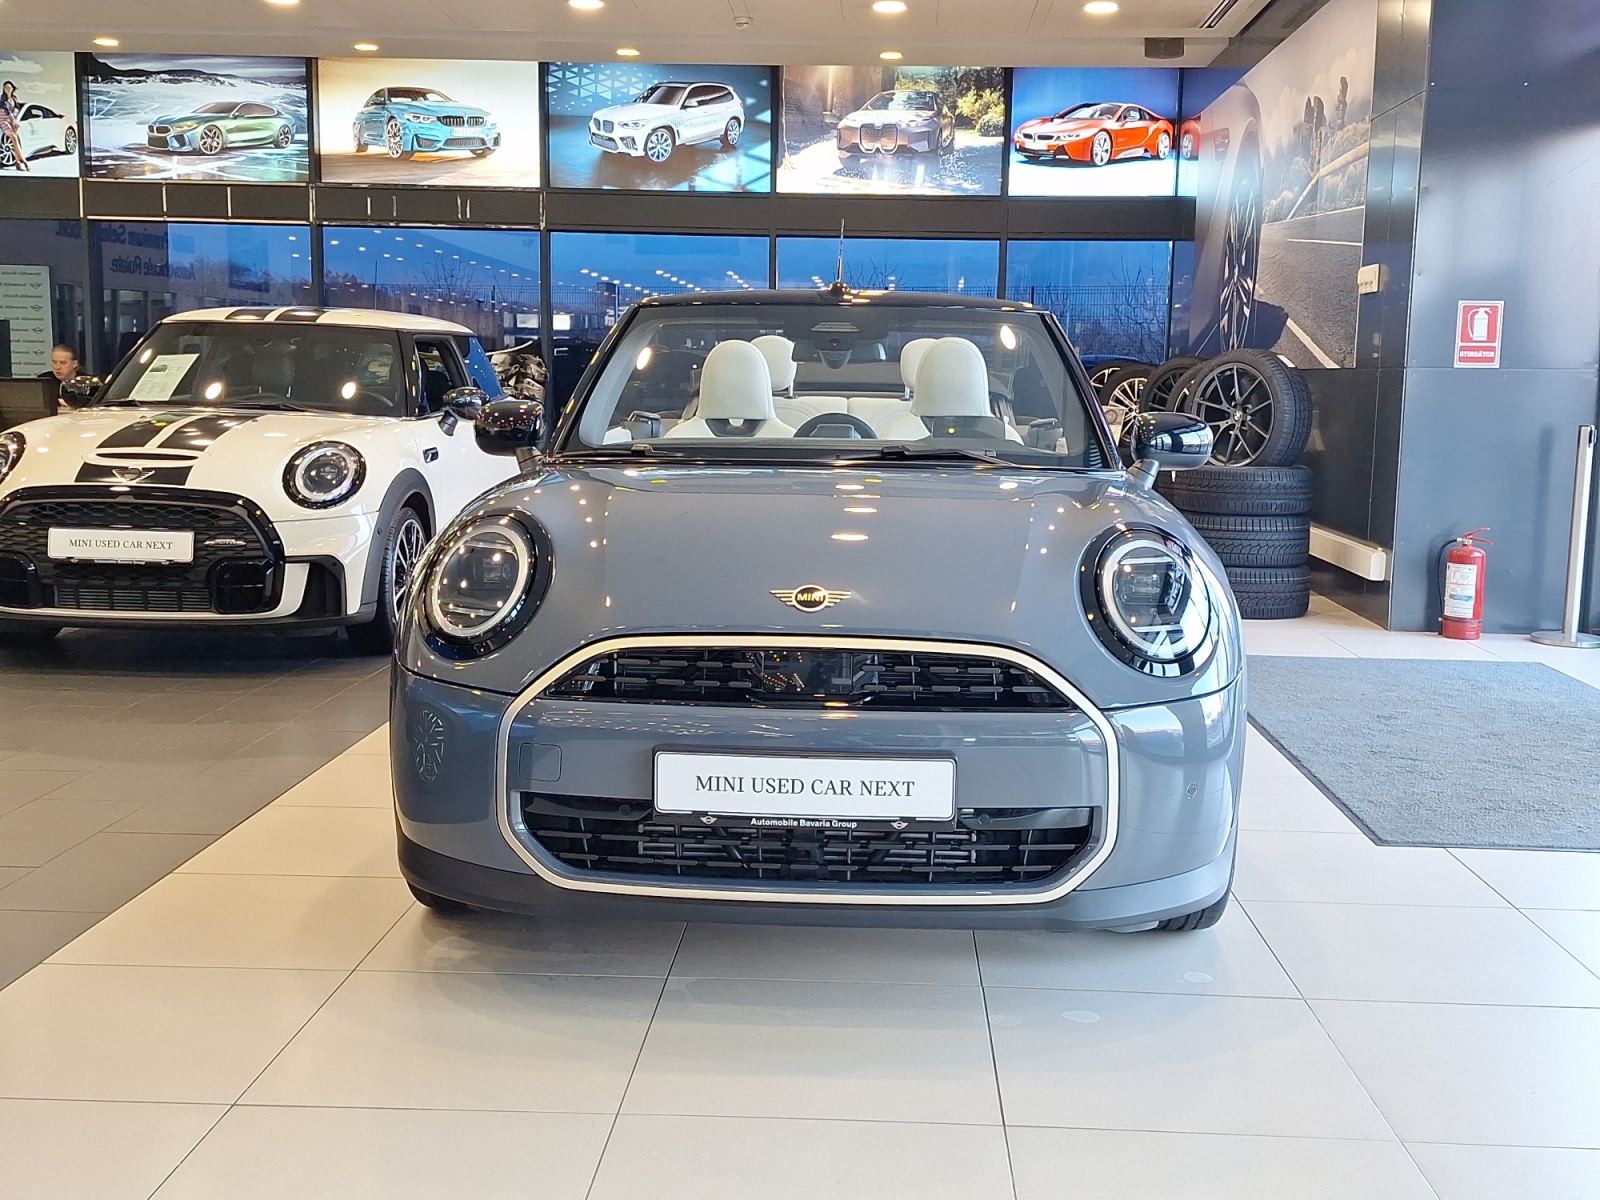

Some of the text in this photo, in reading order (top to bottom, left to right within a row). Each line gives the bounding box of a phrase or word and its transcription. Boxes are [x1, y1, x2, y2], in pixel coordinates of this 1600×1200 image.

[69, 539, 173, 550] MINI USED CAR NEXT
[797, 592, 824, 602] MINI
[695, 775, 915, 797] MINI USED CAR NEXT
[750, 817, 857, 829] Automobile Bavaria Group
